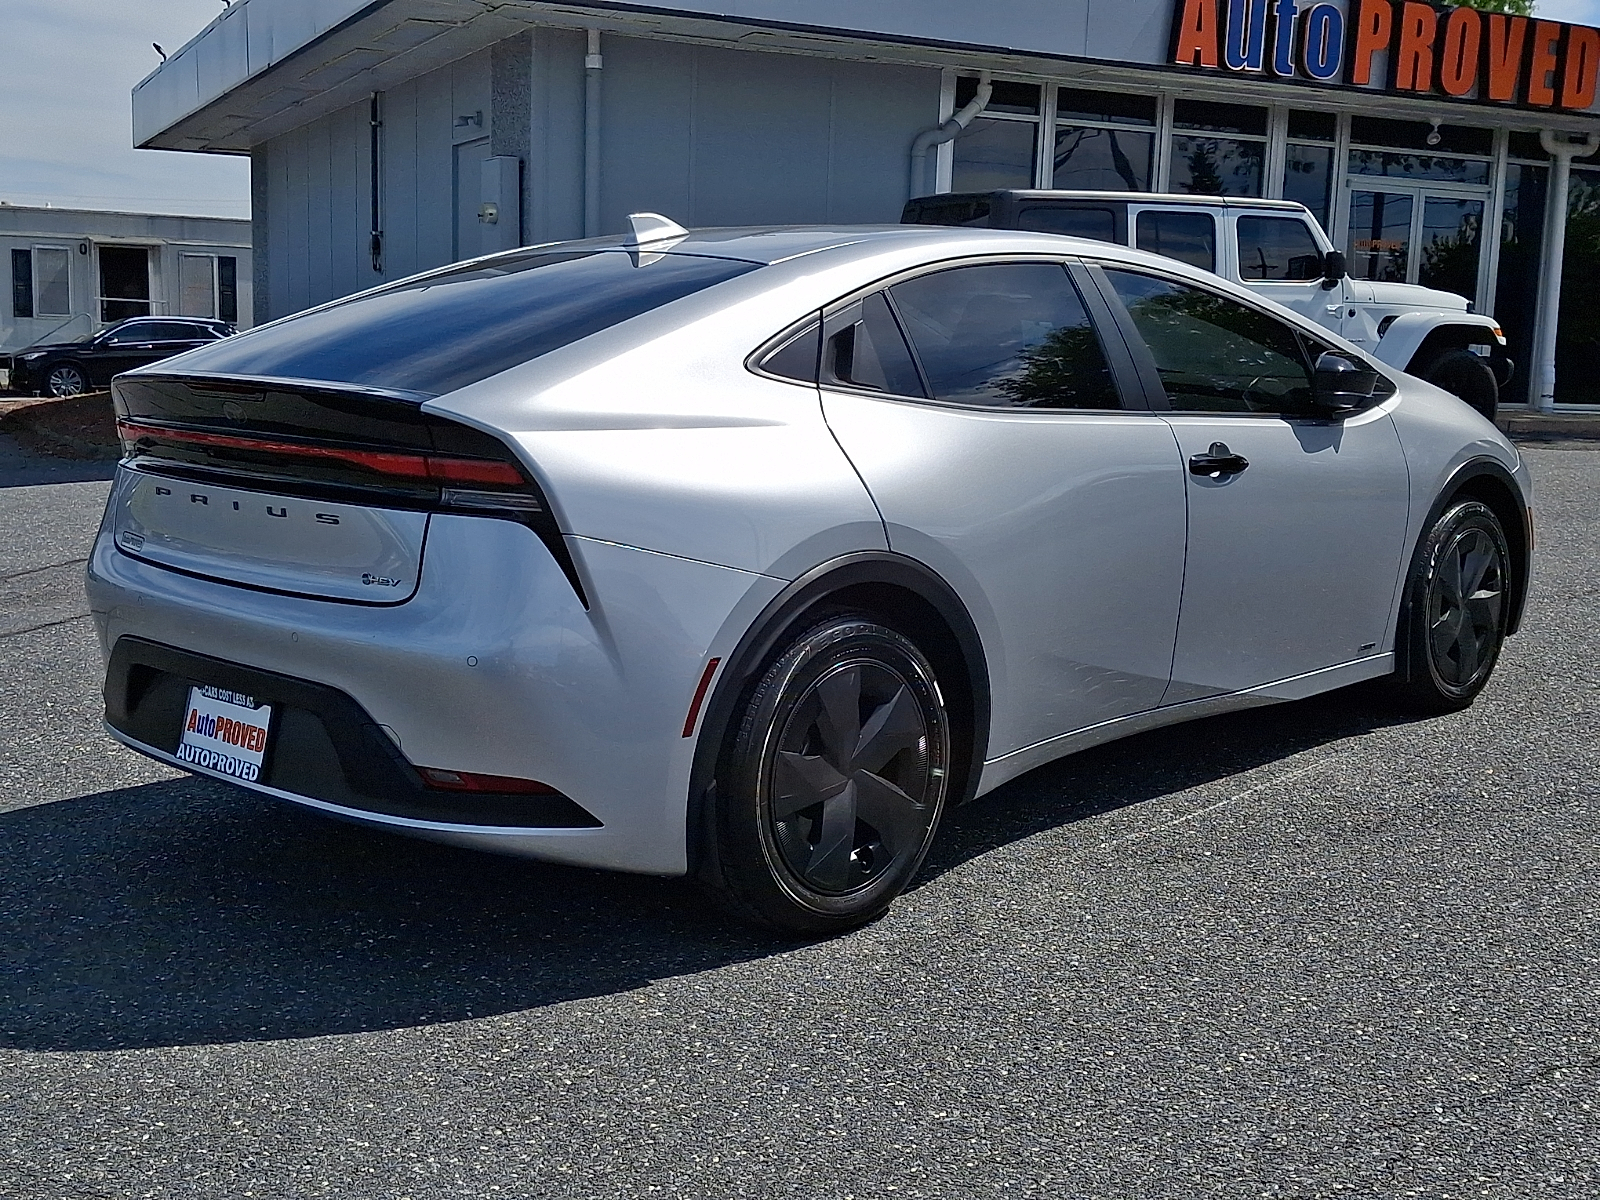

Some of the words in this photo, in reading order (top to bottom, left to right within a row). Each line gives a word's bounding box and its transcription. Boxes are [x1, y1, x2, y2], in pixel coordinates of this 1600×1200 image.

[156, 486, 340, 525] PRIUS
[204, 685, 218, 699] CARS
[218, 688, 233, 702] COST
[232, 692, 246, 706] LESS
[187, 708, 267, 753] AutoPROVED
[176, 743, 259, 781] AUTOPROVED
